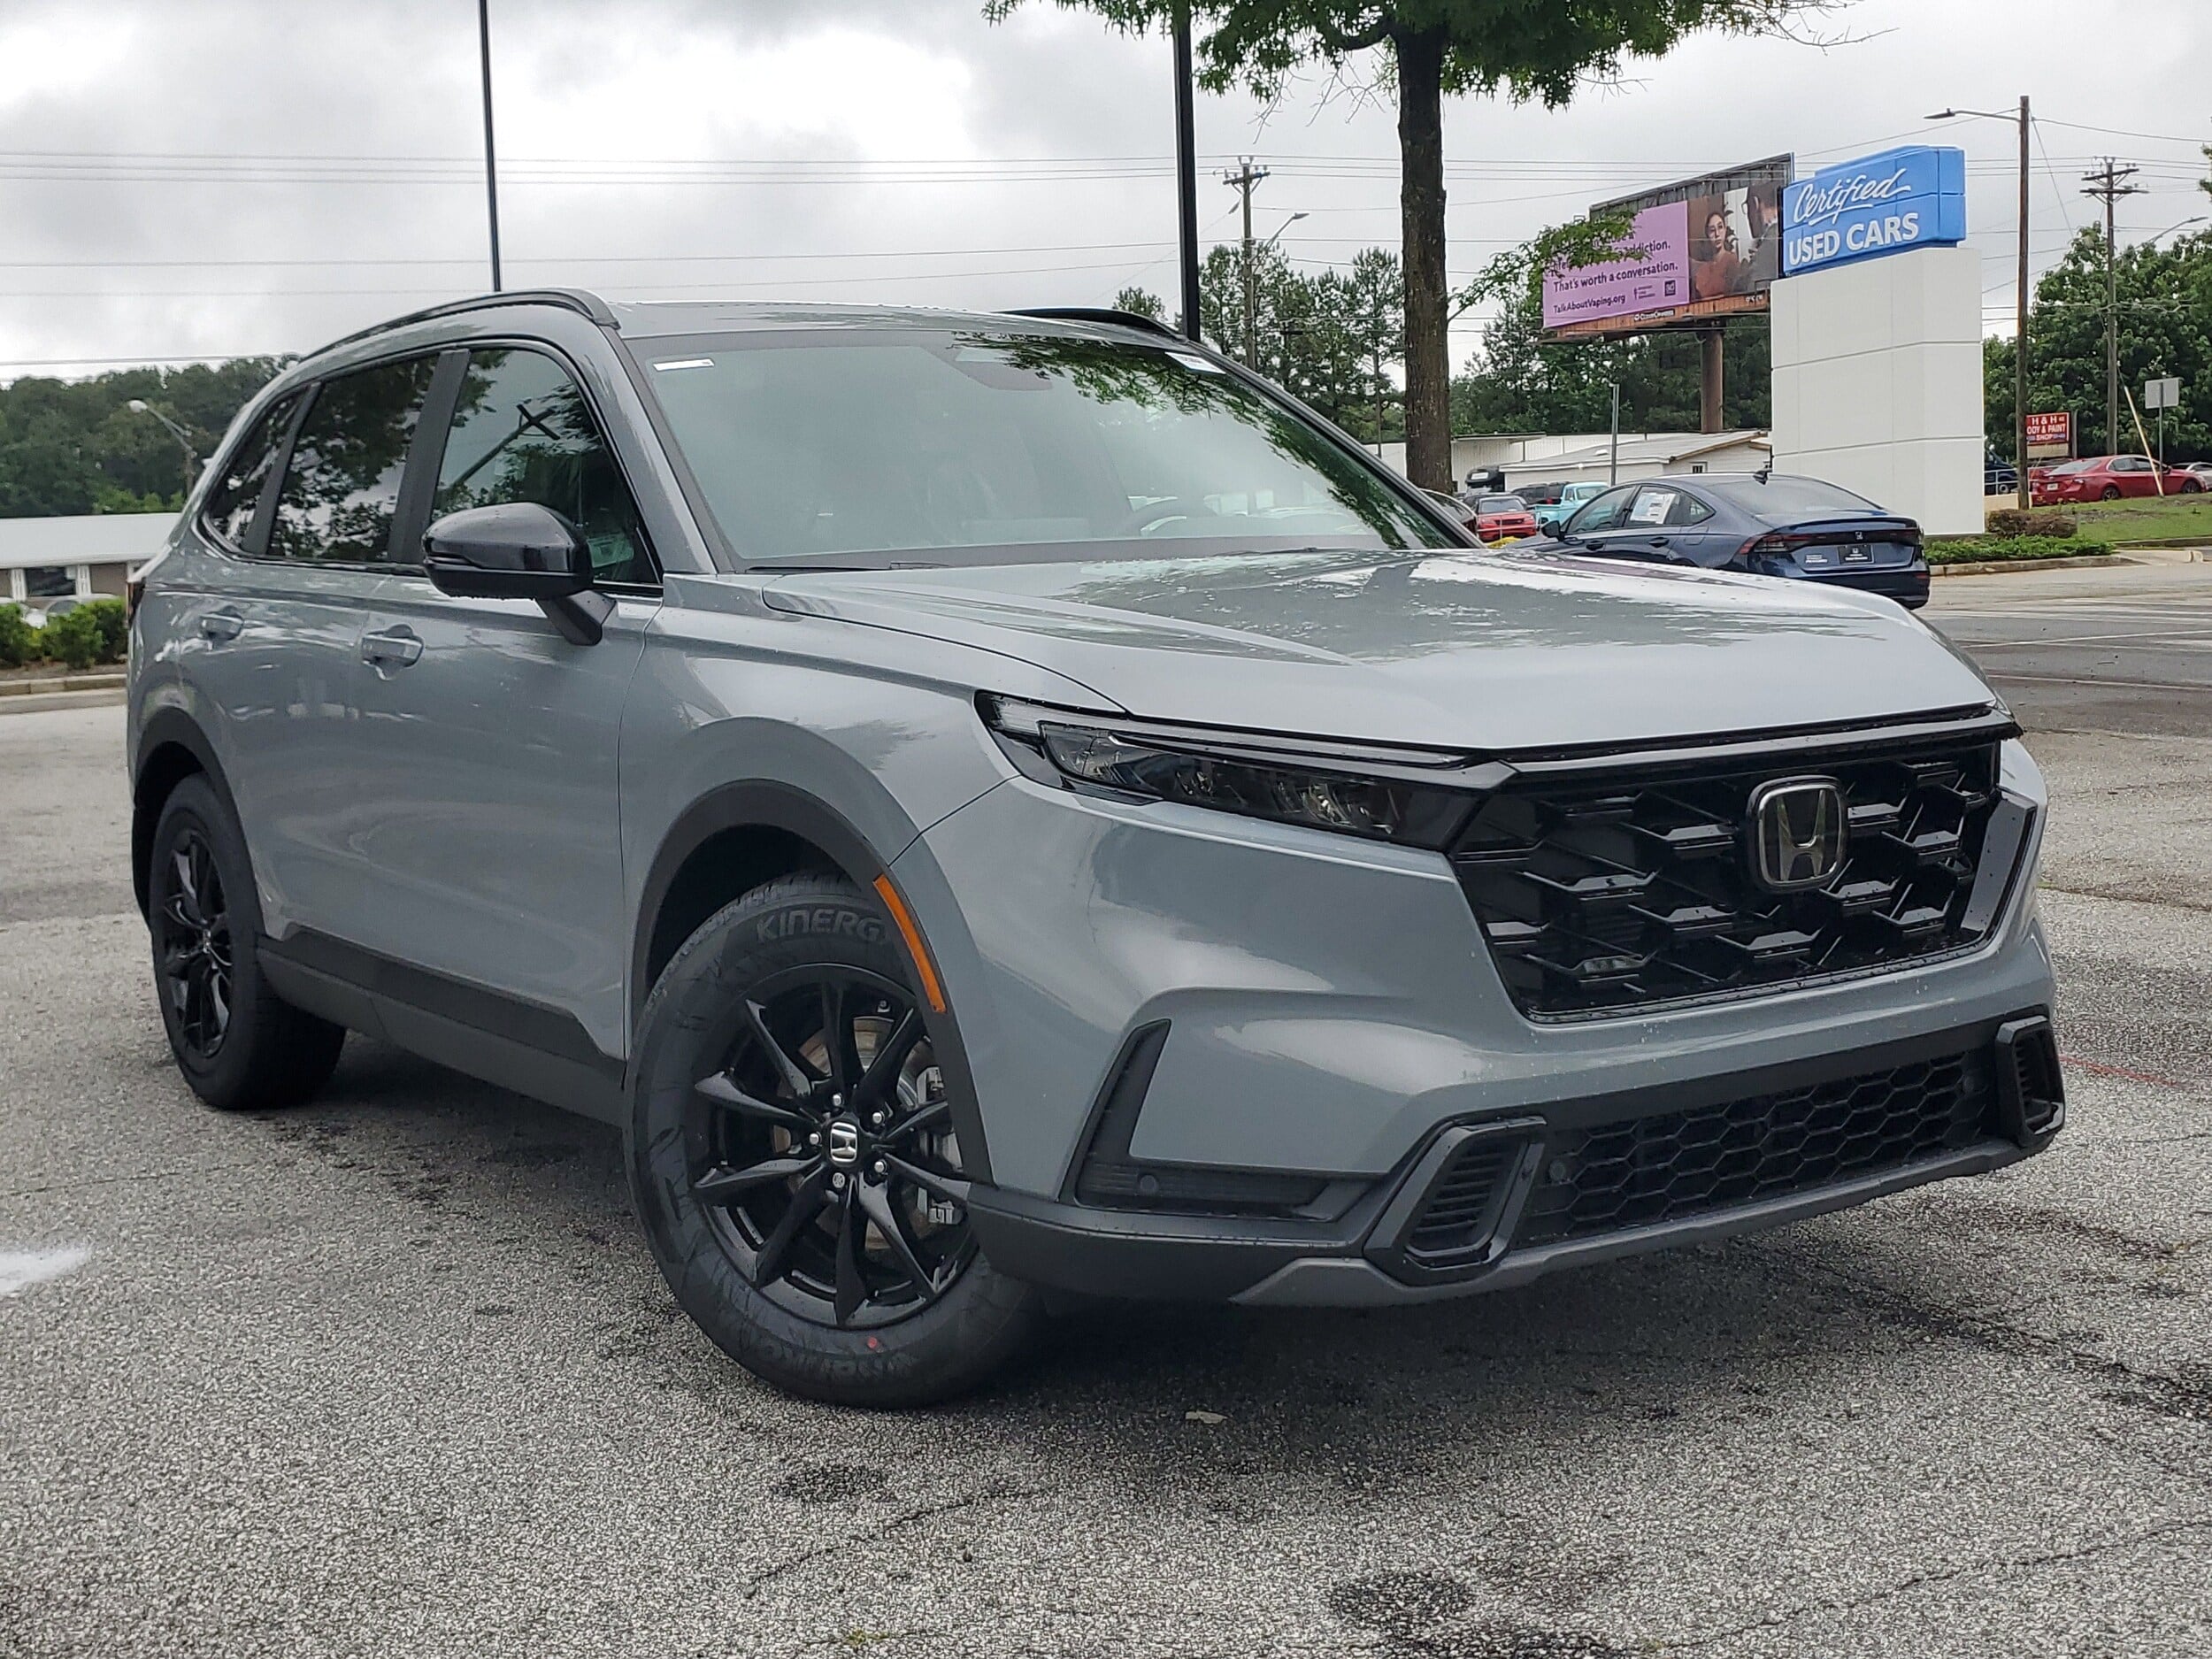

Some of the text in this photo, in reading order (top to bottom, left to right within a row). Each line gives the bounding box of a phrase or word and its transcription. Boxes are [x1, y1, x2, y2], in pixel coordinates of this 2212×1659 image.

[1793, 168, 1911, 226] Certified
[1789, 212, 1919, 265] USED CARS
[1554, 279, 1578, 292] That's
[1580, 272, 1607, 287] worth
[1616, 261, 1678, 280] conversation.
[1554, 295, 1625, 313] TalkAboutVaping.org
[2027, 426, 2040, 434] ODY
[757, 909, 887, 944] KINERG
